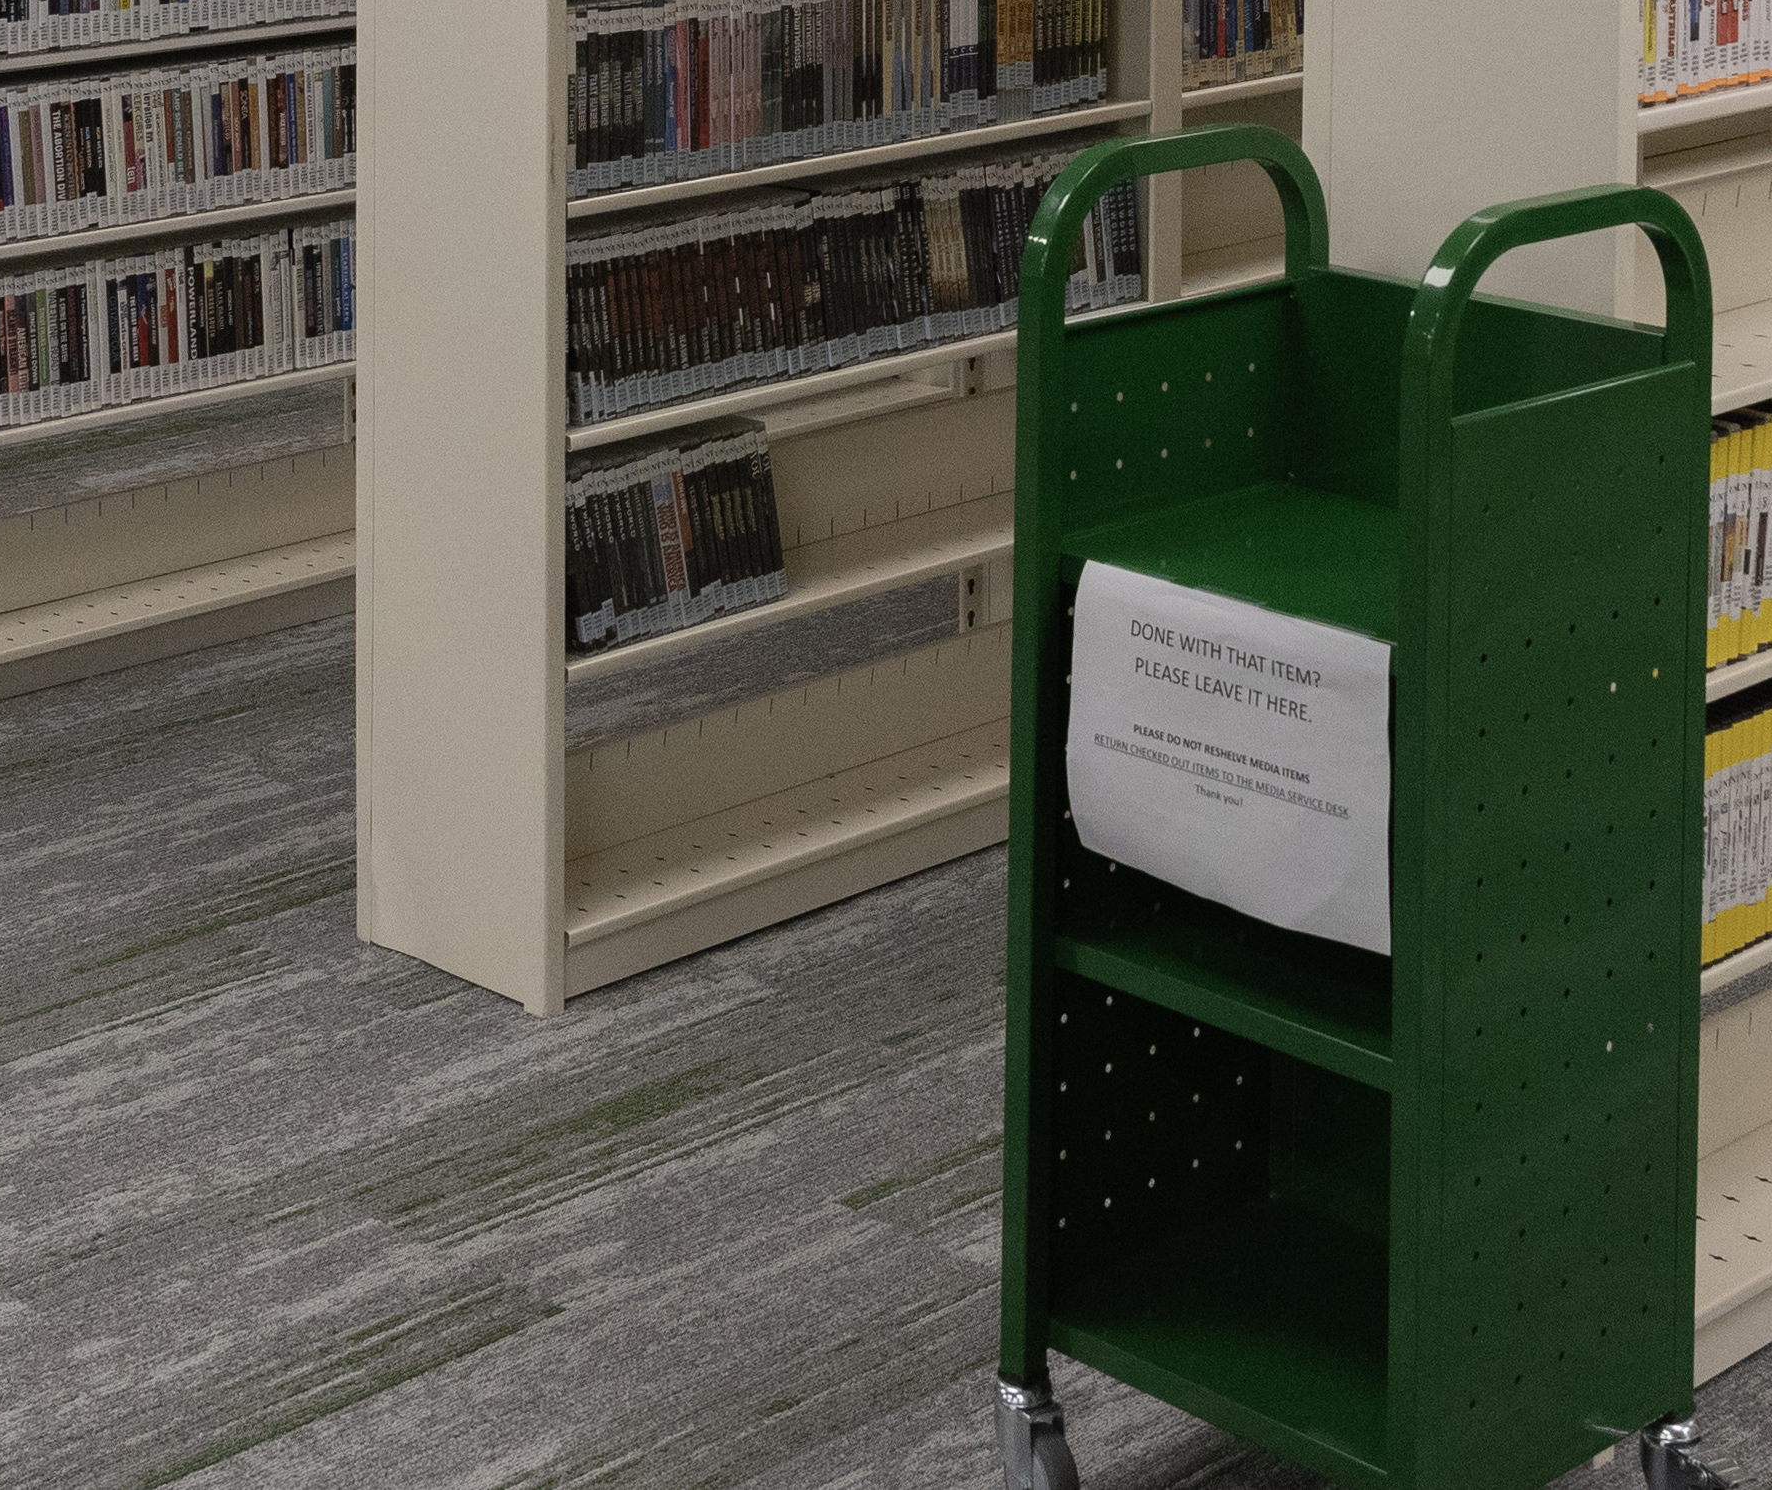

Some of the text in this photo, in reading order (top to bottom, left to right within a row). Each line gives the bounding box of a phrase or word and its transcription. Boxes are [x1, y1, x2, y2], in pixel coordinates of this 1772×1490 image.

[187, 266, 199, 360] POWERLAND
[1131, 619, 1321, 688] DONE WITH THAT ITEM?
[1135, 657, 1312, 724] PLEASE LEAVE IT HERE.
[1094, 733, 1129, 752] RETURN
[1130, 743, 1170, 764] CHECKED
[1171, 756, 1190, 771] OUT
[1192, 761, 1221, 779] ITEMS
[1222, 771, 1235, 784] TO
[1235, 774, 1254, 789] THE
[1255, 780, 1286, 799] MEDIA
[1287, 789, 1325, 809] SERVICE
[1133, 723, 1311, 785] PLEASE DO NOT RESHELVE MEDIA ITEMS
[1194, 783, 1243, 809] Thank you!
